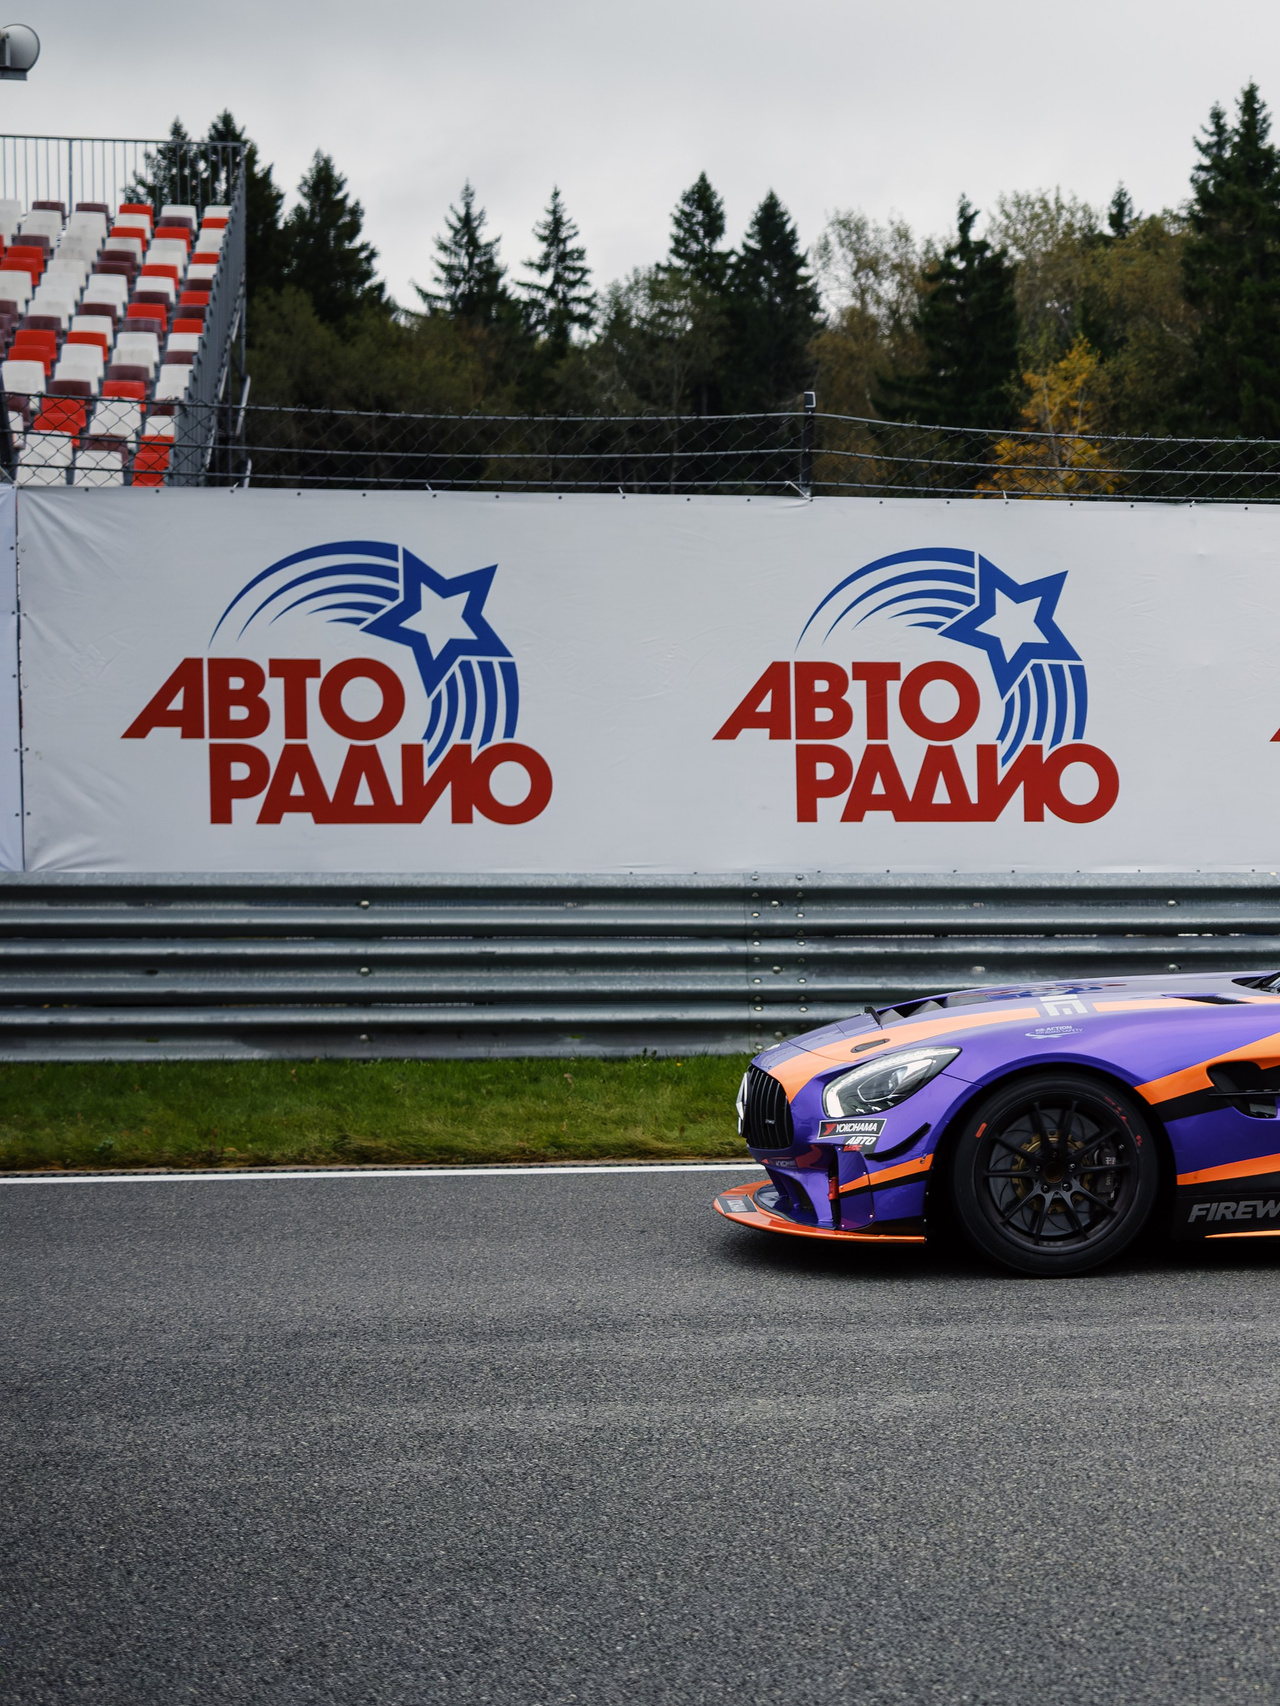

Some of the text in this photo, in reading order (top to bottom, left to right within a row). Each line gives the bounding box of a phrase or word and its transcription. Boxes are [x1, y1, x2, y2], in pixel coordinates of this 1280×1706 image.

[122, 658, 405, 741] АВТО
[714, 661, 980, 742] АВТО
[210, 743, 553, 825] РАДИО
[796, 744, 1120, 824] РАДИО
